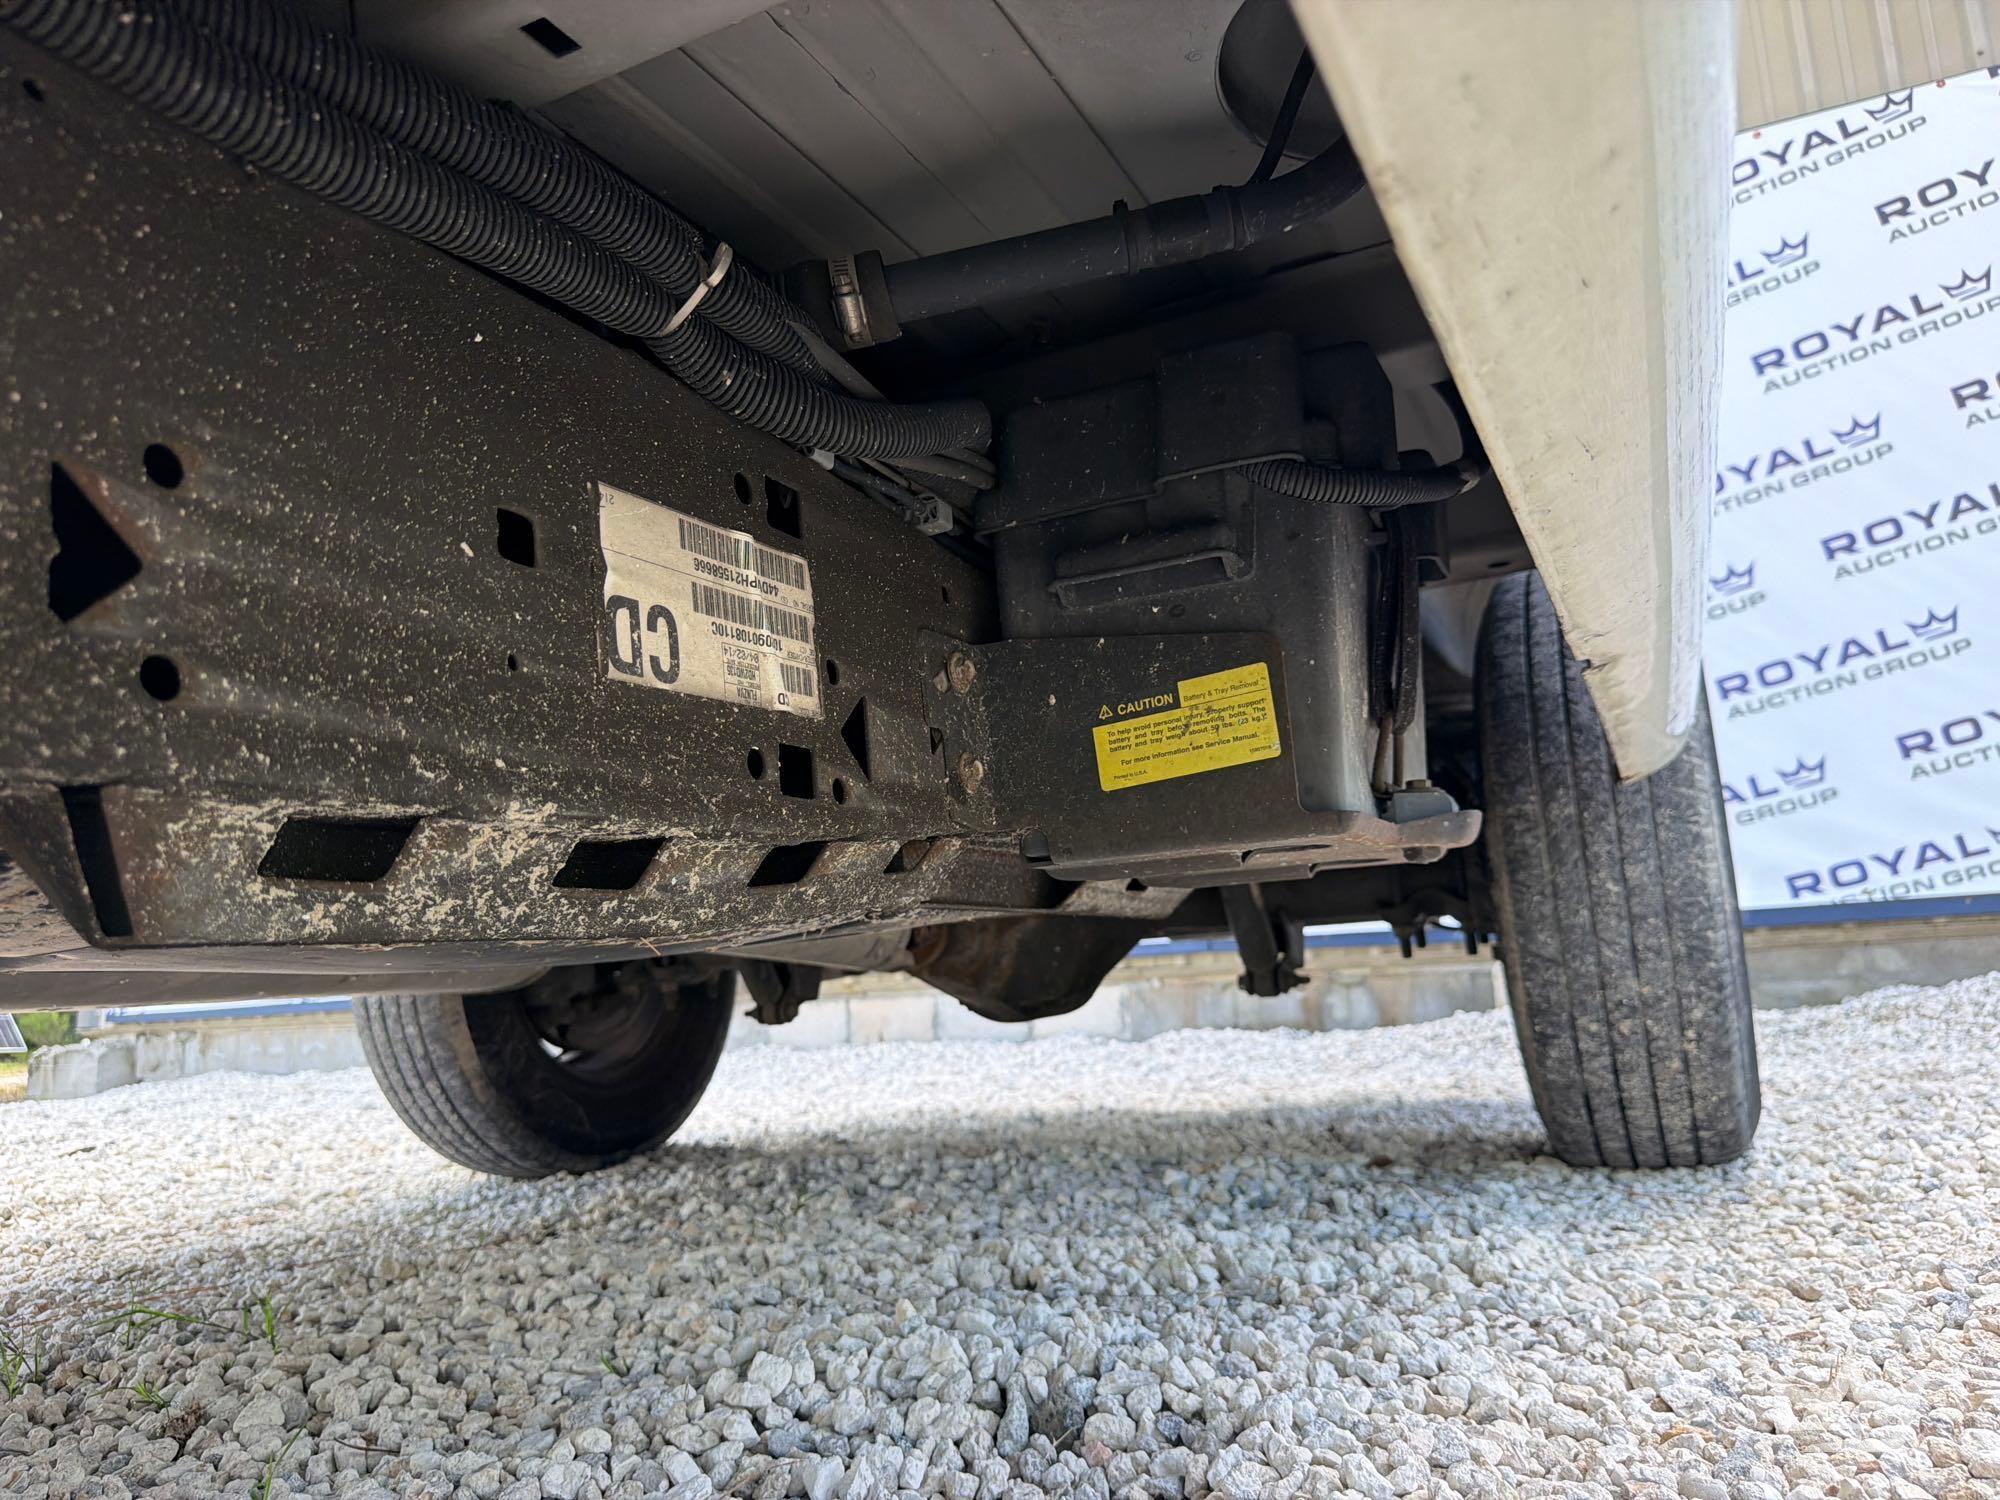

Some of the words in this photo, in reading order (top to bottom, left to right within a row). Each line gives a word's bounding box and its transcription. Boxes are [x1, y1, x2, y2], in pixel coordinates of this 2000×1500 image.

[1731, 160, 1819, 208] CTION
[1825, 115, 1927, 168] GROUP
[1732, 118, 1869, 187] OYAL
[1874, 157, 1995, 227] ROY
[1889, 190, 2000, 244] AUCTIO
[1727, 259, 1821, 309] GROUP
[1751, 293, 1944, 377] ROYAL
[1763, 336, 1892, 395] AUCTION
[1897, 296, 2000, 344] GROUP
[1714, 481, 1784, 517] TION
[1790, 441, 1894, 489] GROUP
[1715, 438, 1836, 494] YAL
[1834, 526, 1970, 581] AUCTION
[1705, 591, 1766, 623] OUP
[605, 595, 680, 685] CD
[1715, 628, 1910, 702] ROYAL
[777, 692, 790, 707] D
[1117, 693, 1174, 715] CAUTION
[1183, 691, 1206, 702] Battery
[1214, 687, 1229, 696] Tray
[1230, 680, 1259, 692] Removal
[1727, 671, 1858, 721] AUCTION
[1863, 638, 1972, 681] GROUP
[1108, 736, 1131, 746] battery
[1134, 732, 1147, 740] and
[1151, 729, 1164, 737] tray
[1193, 715, 1225, 727] removing
[1109, 743, 1132, 753] battery
[1134, 740, 1148, 748] and
[1149, 736, 1163, 744] tray
[1188, 727, 1208, 736] about
[1221, 720, 1235, 729] lbs.
[1117, 727, 1132, 736] help
[1133, 722, 1152, 732] avoid
[1153, 716, 1182, 728] personal
[1134, 755, 1151, 763] more
[1152, 746, 1191, 760] information
[1205, 738, 1231, 748] Service
[1232, 731, 1260, 743] Manual.
[1910, 742, 2000, 782] AUCTI
[1734, 786, 1840, 826] GROUP
[1784, 833, 1991, 899] ROYAL
[1831, 874, 1935, 906] CTION
[1941, 858, 2000, 887] GRO
